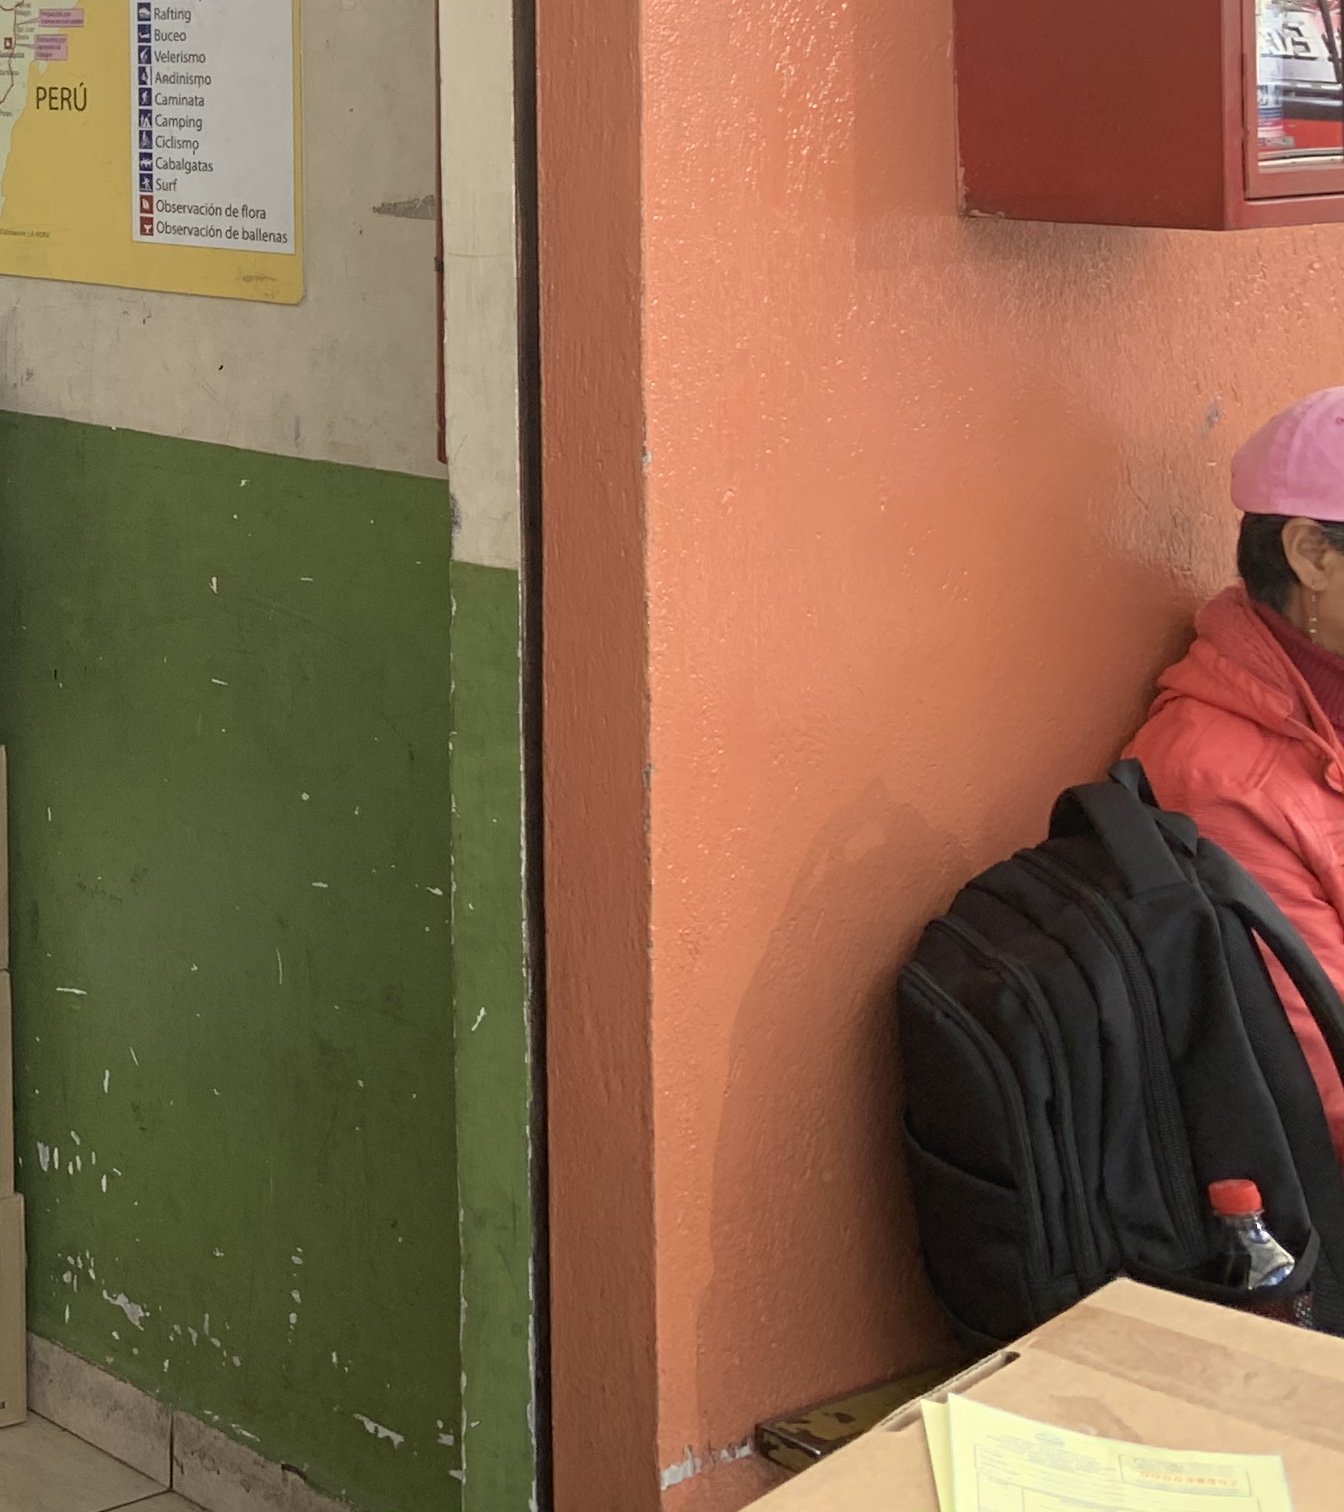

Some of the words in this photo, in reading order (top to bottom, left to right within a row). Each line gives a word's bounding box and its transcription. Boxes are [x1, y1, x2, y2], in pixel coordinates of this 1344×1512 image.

[154, 7, 191, 23] Rafting
[154, 29, 186, 42] Buceo
[154, 50, 206, 64] Velerismo
[155, 72, 212, 86] Andinismo
[36, 83, 88, 112] PERÚ
[155, 92, 205, 107] Caminata
[155, 114, 203, 131] Camping
[155, 135, 199, 150] Ciclismo
[155, 157, 213, 174] Cabalgatas
[155, 178, 177, 191] Surf
[156, 200, 222, 217] Observación
[224, 204, 239, 218] de
[241, 204, 266, 220] flora
[156, 221, 222, 238] Observación
[225, 226, 239, 239] de
[242, 228, 288, 244] ballenas
